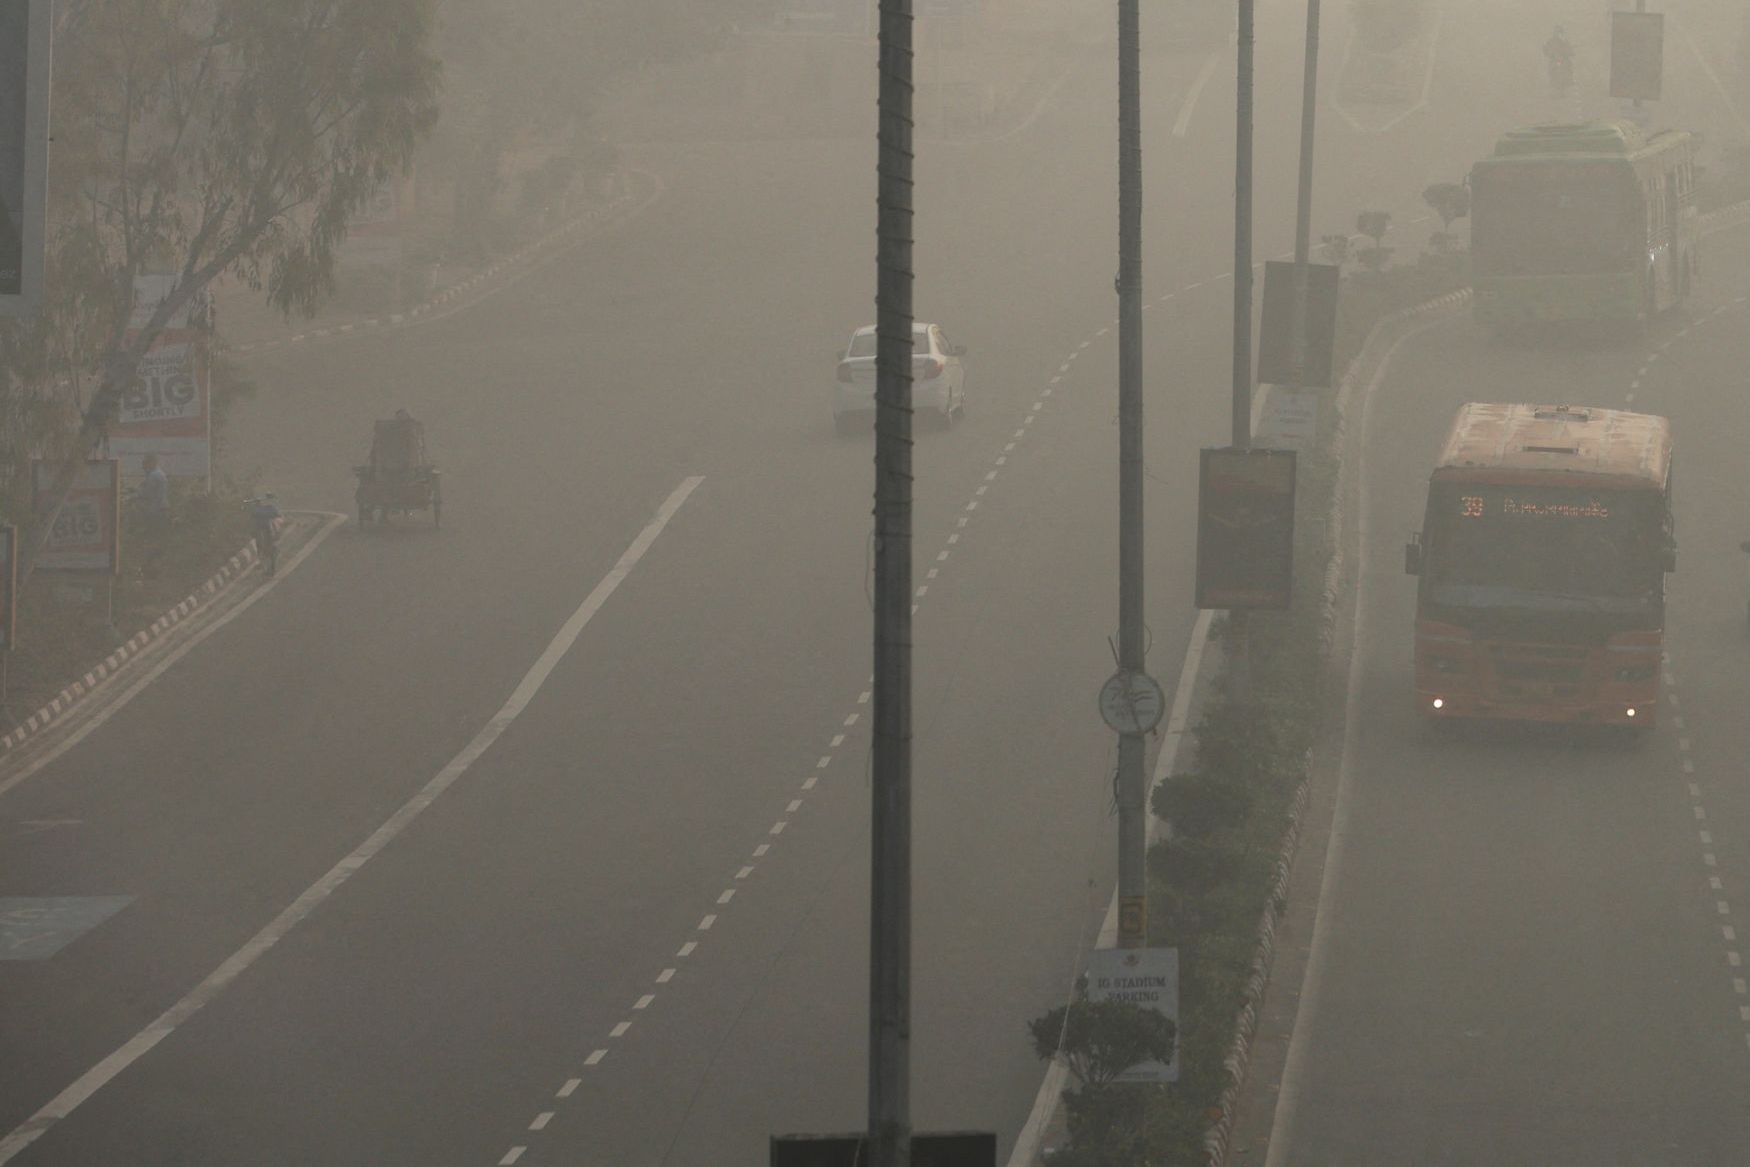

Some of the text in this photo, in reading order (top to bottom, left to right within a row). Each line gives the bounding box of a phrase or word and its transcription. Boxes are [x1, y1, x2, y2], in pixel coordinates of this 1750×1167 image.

[124, 376, 194, 410] BIG
[133, 406, 184, 420] SHORTLY
[52, 516, 98, 539] BIG
[1113, 976, 1166, 989] STADIUM
